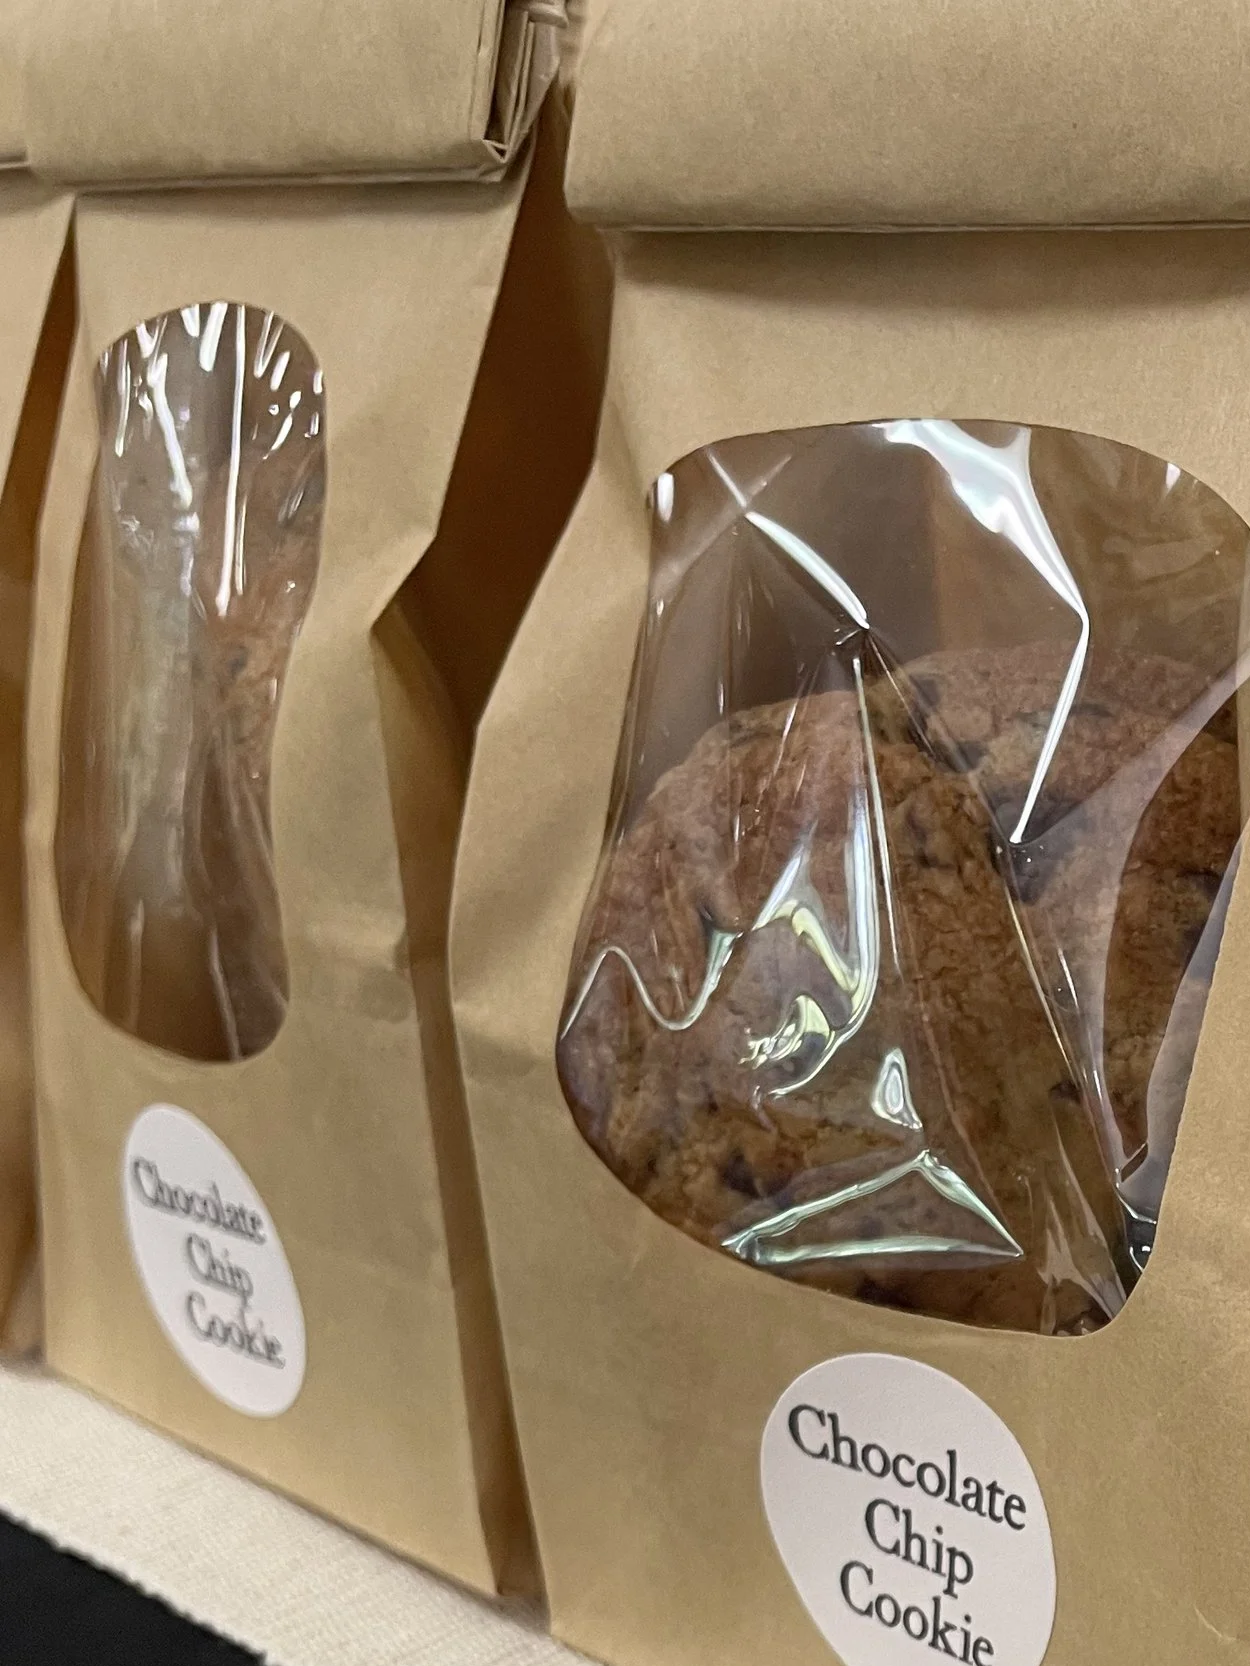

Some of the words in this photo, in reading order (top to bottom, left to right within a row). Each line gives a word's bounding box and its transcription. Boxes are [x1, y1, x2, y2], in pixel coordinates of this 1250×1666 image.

[131, 1157, 266, 1245] Chocolate
[186, 1232, 254, 1307] Chip
[186, 1290, 286, 1369] Cookie
[788, 1403, 1027, 1531] Chocolate
[864, 1498, 974, 1599] Chip
